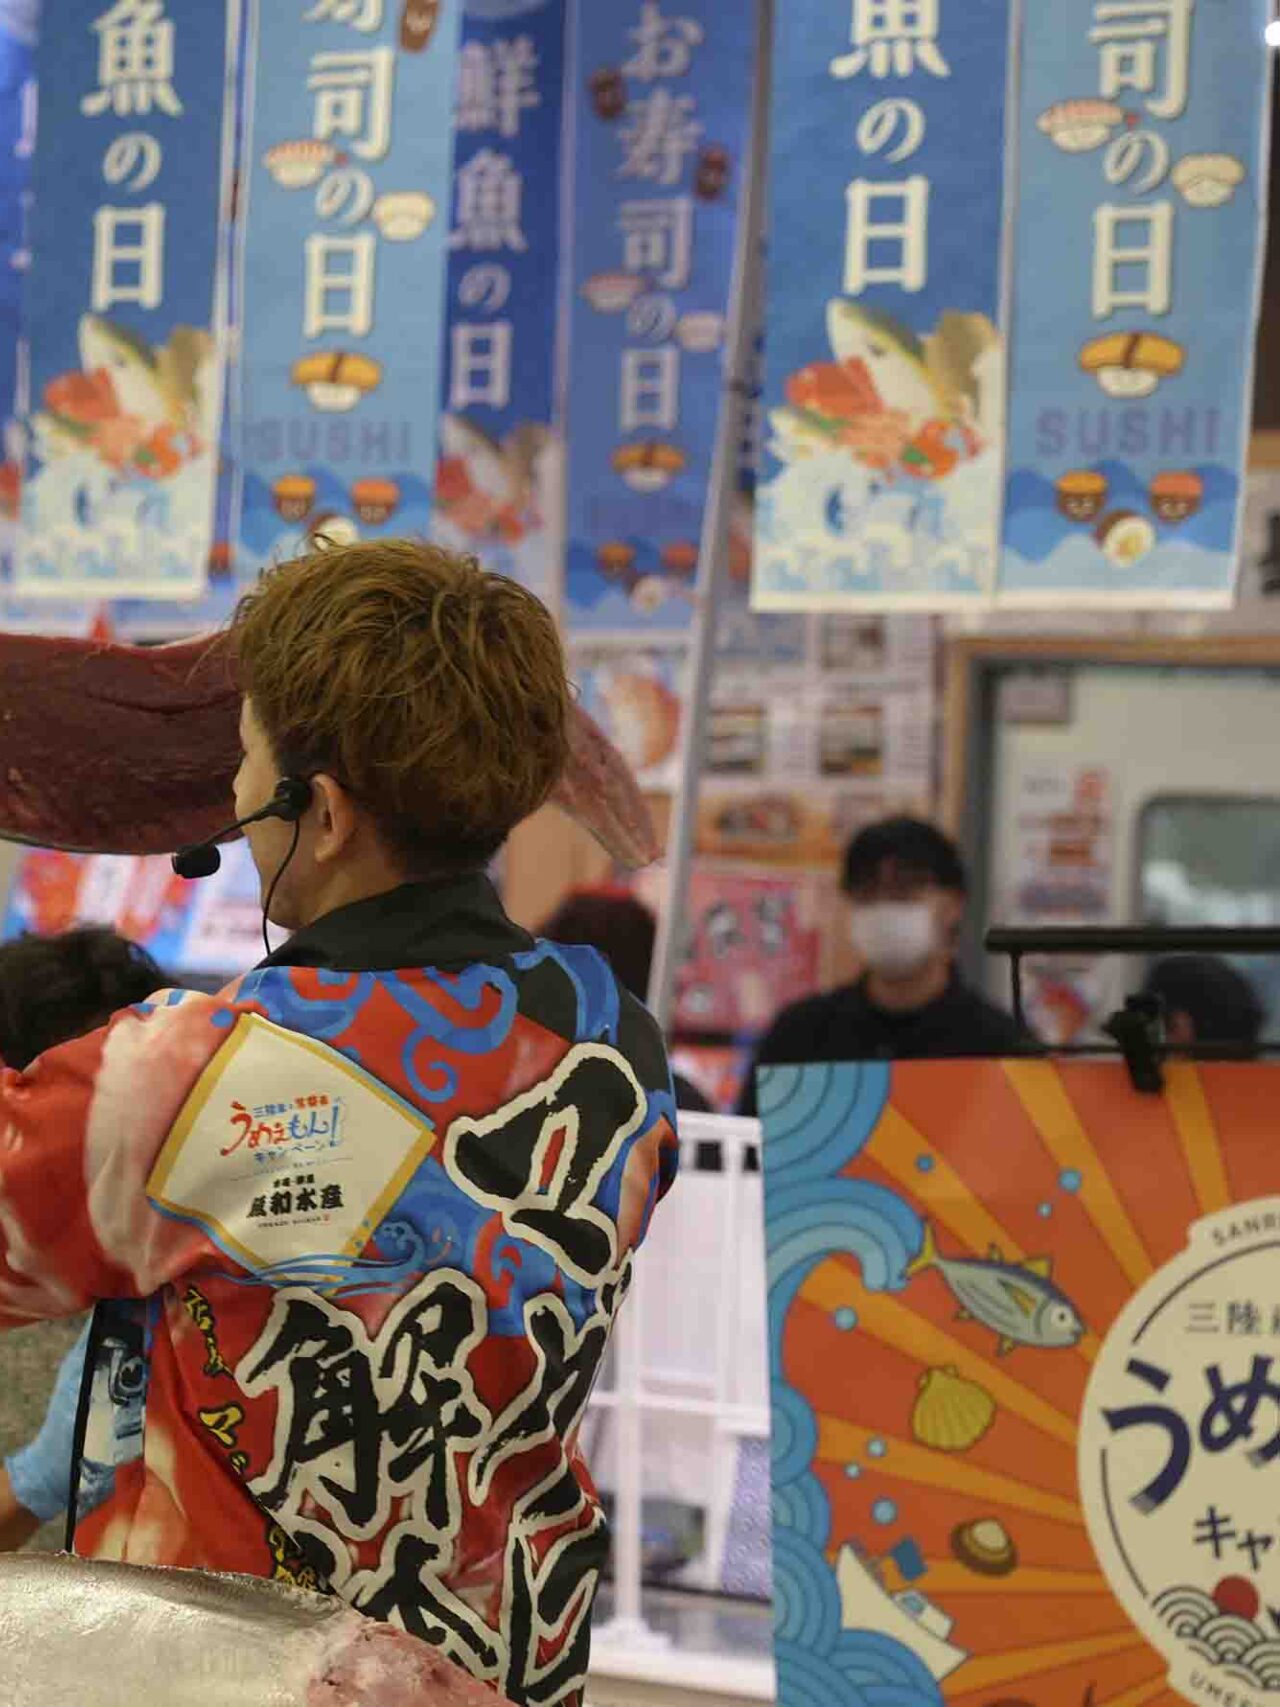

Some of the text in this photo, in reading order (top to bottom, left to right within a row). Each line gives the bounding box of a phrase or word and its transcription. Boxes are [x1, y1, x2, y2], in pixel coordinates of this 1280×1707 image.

[81, 0, 184, 311] 魚の日
[448, 34, 539, 411] 鮮魚の日
[616, 2, 704, 433] お寿司の日
[258, 418, 412, 463] SUSHI
[1034, 405, 1223, 459] SUSHI
[1185, 1301, 1280, 1335] 三陸
